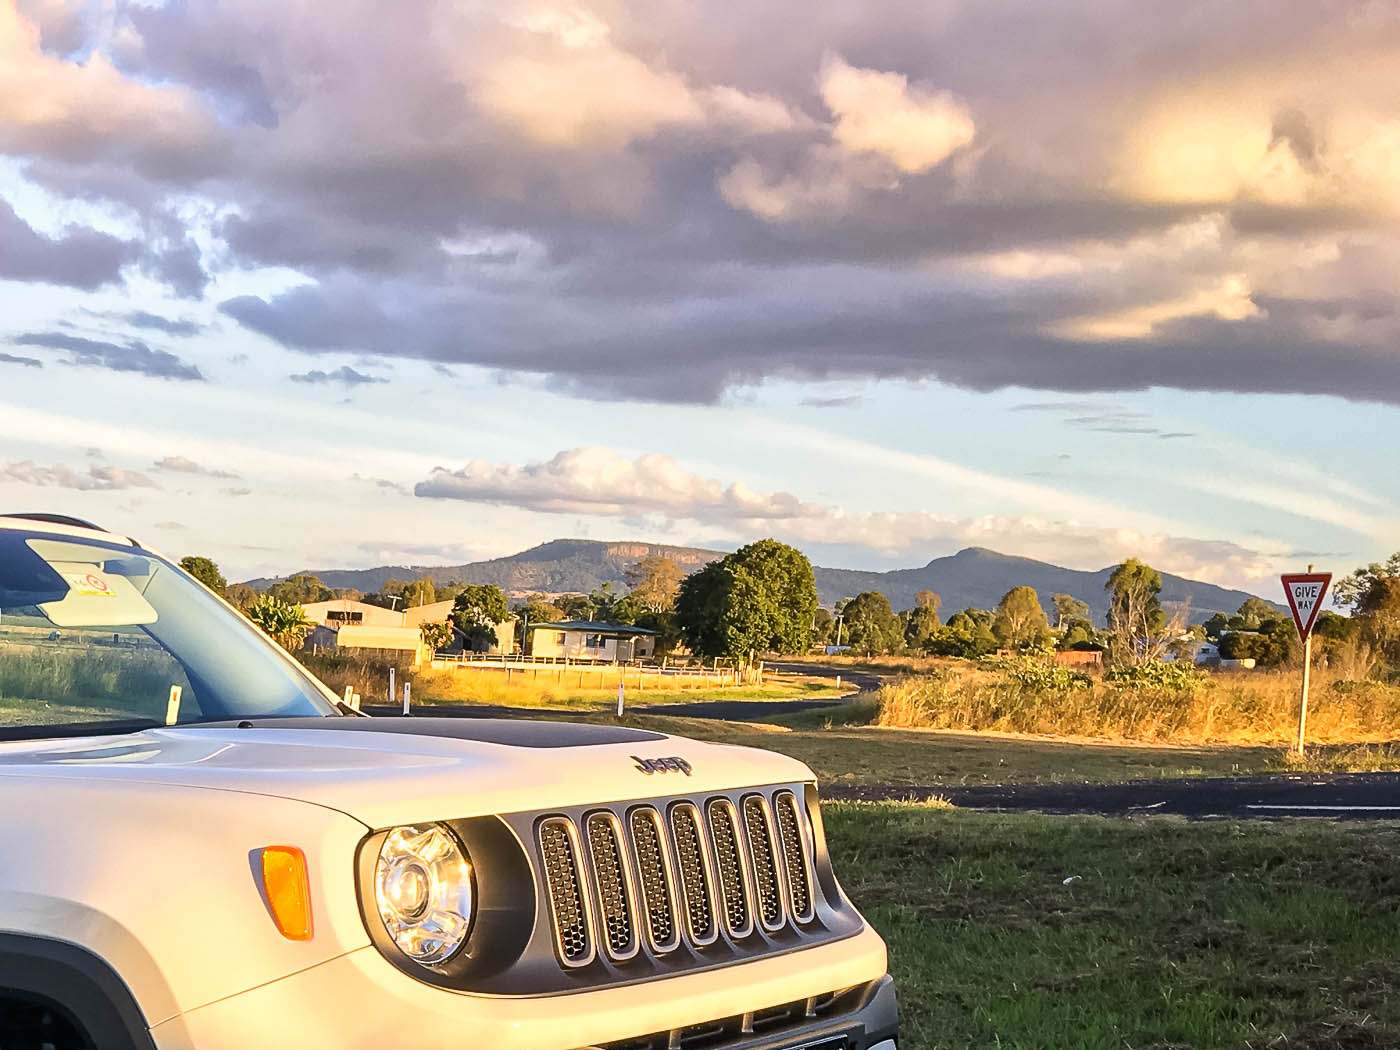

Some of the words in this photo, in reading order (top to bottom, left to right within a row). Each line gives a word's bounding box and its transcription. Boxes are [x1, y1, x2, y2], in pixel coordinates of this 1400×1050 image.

[1295, 586, 1317, 598] GIVE
[1298, 601, 1313, 610] WAY
[629, 755, 693, 777] Jeep
